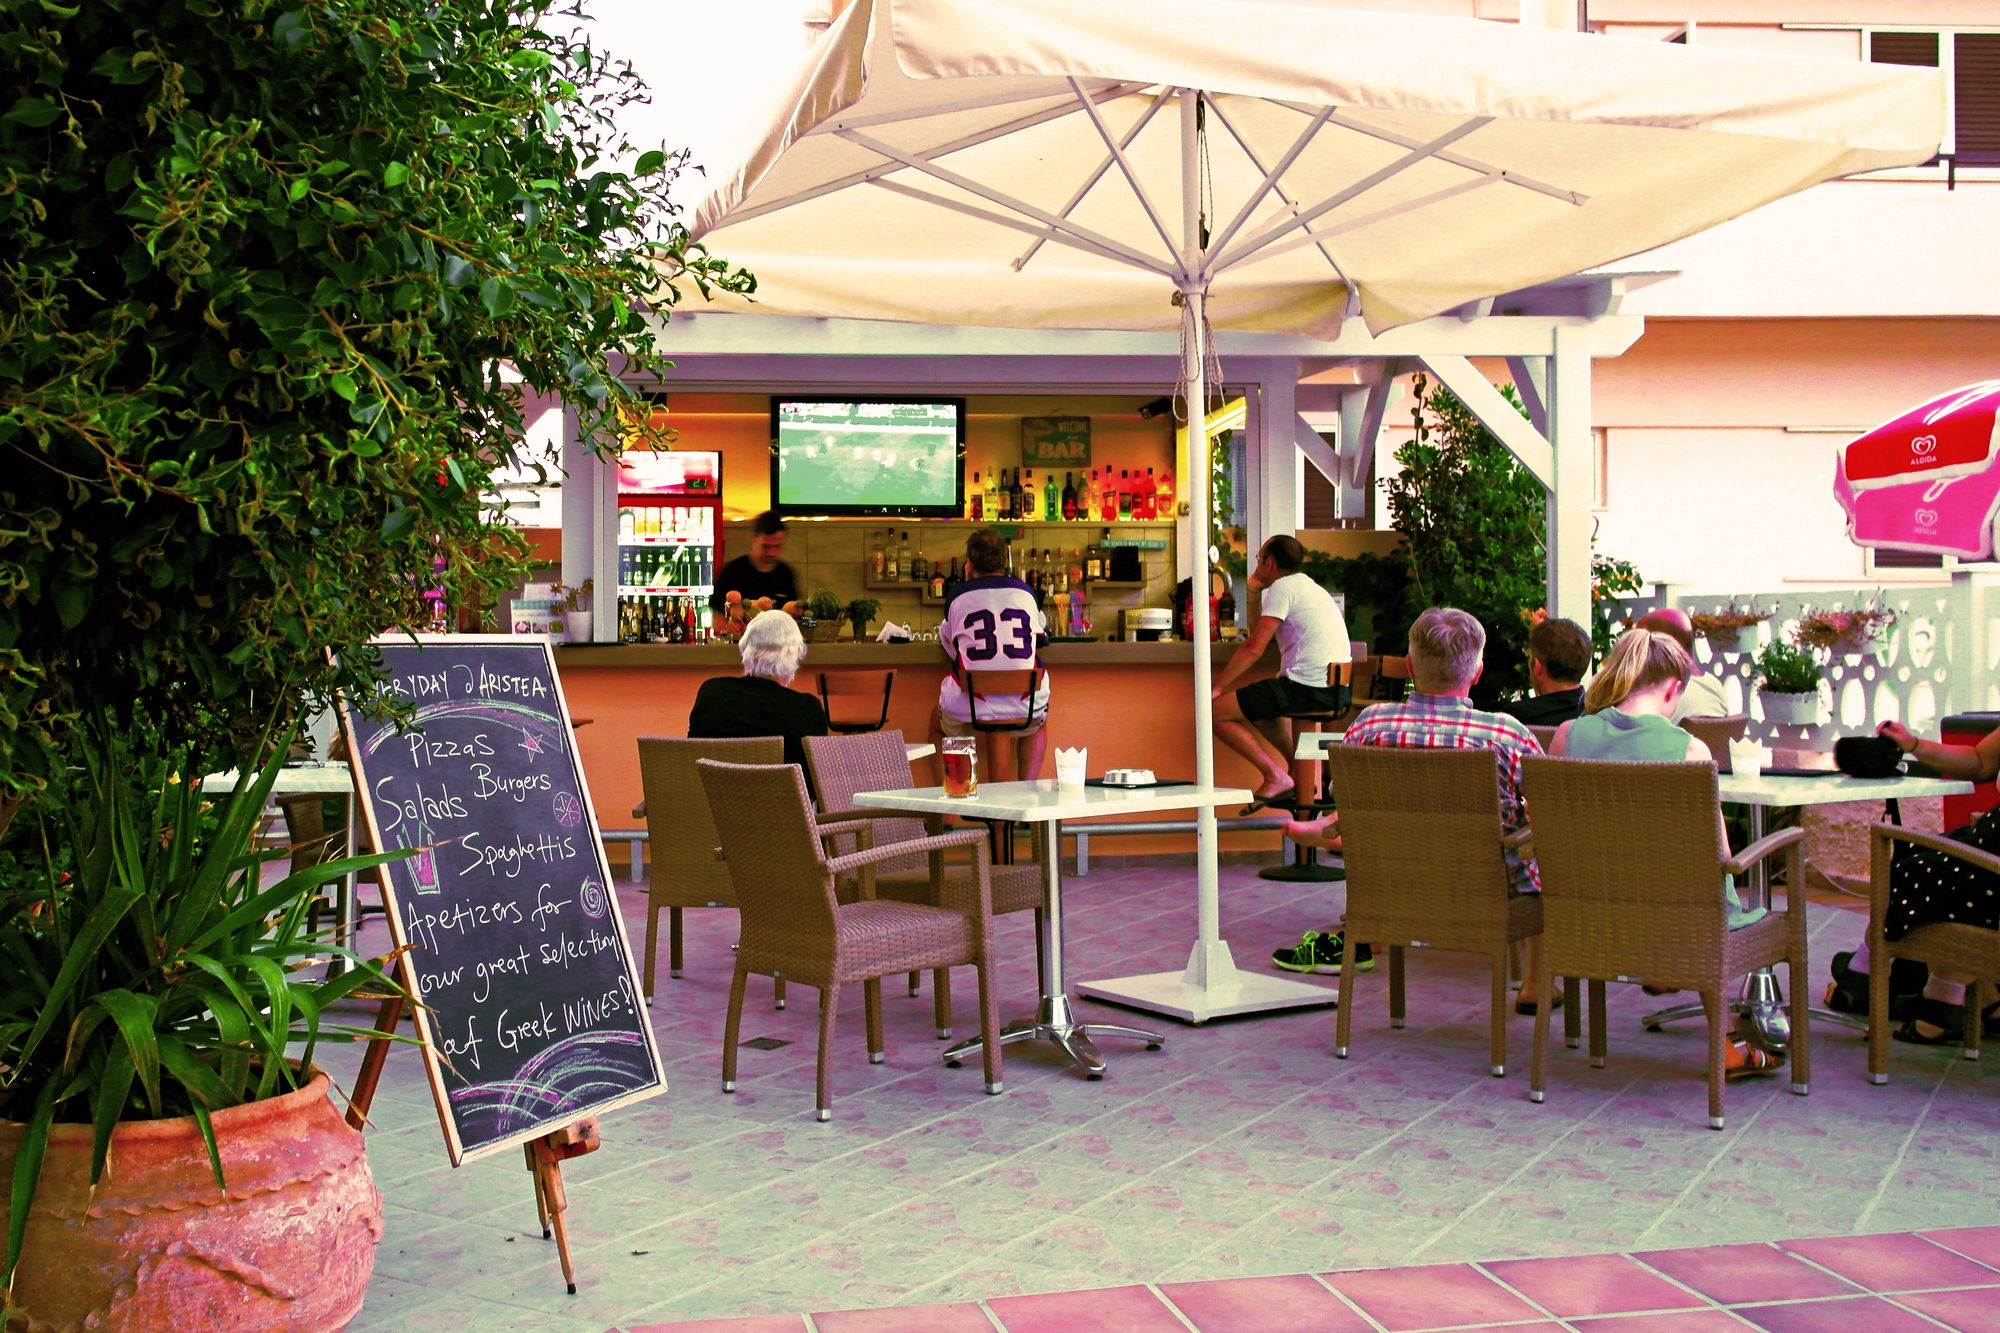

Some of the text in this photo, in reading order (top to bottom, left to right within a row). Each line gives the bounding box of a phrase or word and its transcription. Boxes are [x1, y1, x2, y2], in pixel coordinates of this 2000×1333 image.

[1038, 441, 1086, 459] BAR
[1910, 455, 1937, 466] ALGIDA
[963, 607, 1033, 662] 33
[478, 662, 548, 704] ARISTEA
[404, 731, 495, 768] Pizzas
[375, 775, 469, 832] Salads
[470, 763, 552, 803] Burgers
[459, 832, 577, 878] Spaghettis
[407, 883, 573, 955] Apetizers for
[419, 928, 621, 1003] our great selection
[496, 1001, 558, 1054] Greek
